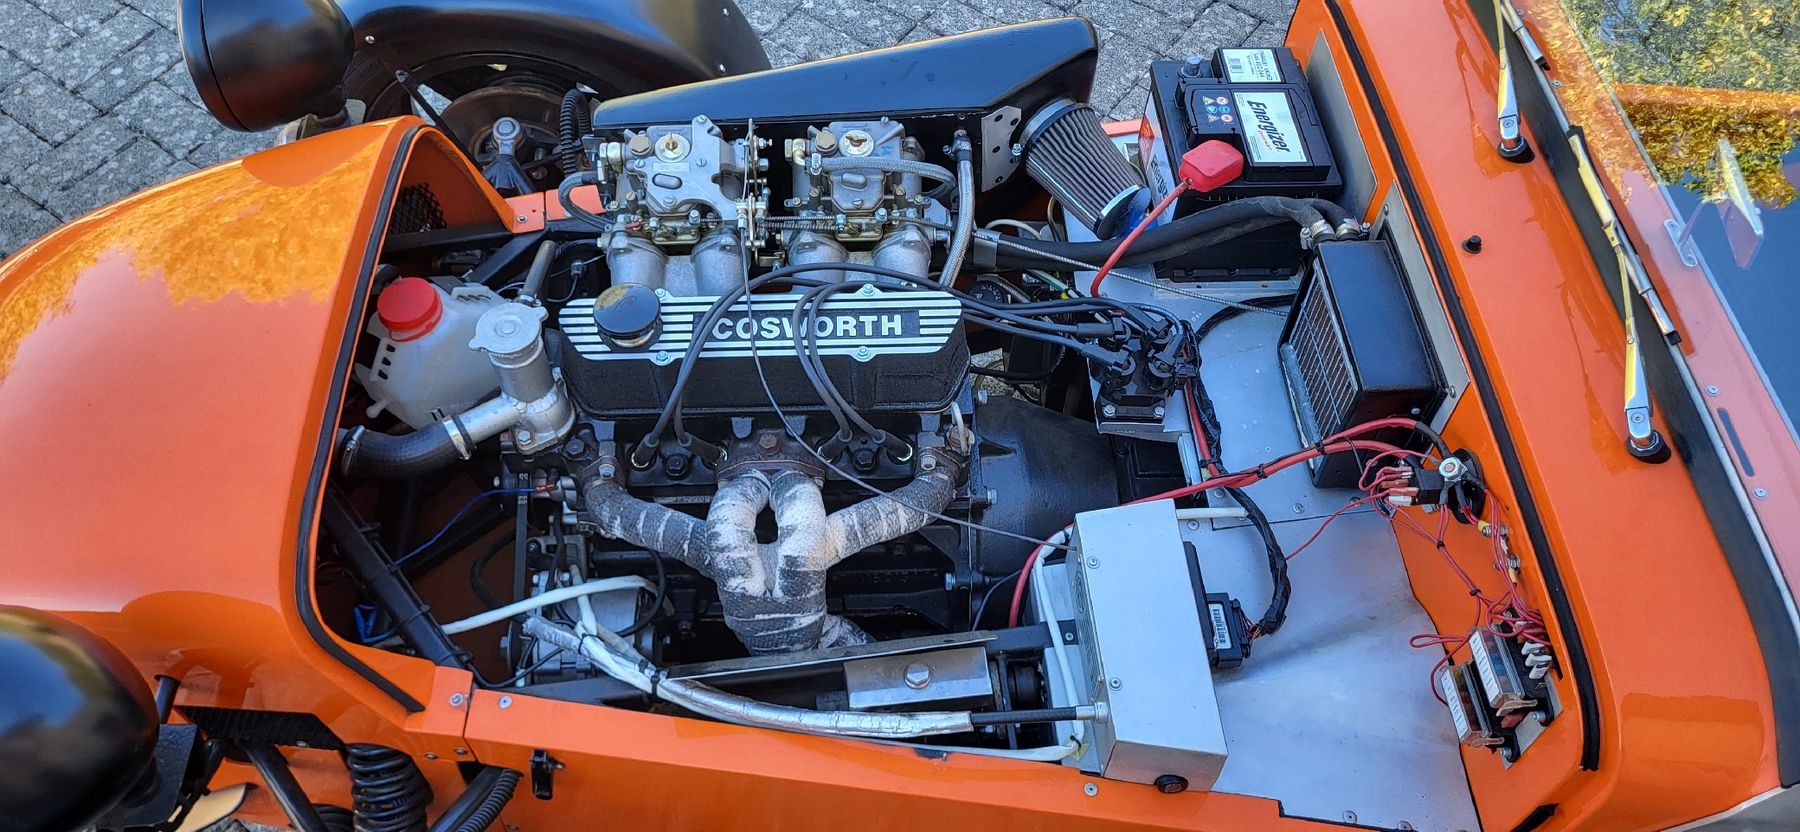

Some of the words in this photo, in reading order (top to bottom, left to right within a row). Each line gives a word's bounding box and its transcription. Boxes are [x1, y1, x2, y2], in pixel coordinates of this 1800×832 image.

[1246, 100, 1291, 153] Energizer
[1150, 153, 1170, 200] Energiz
[712, 314, 903, 341] COSWORTH
